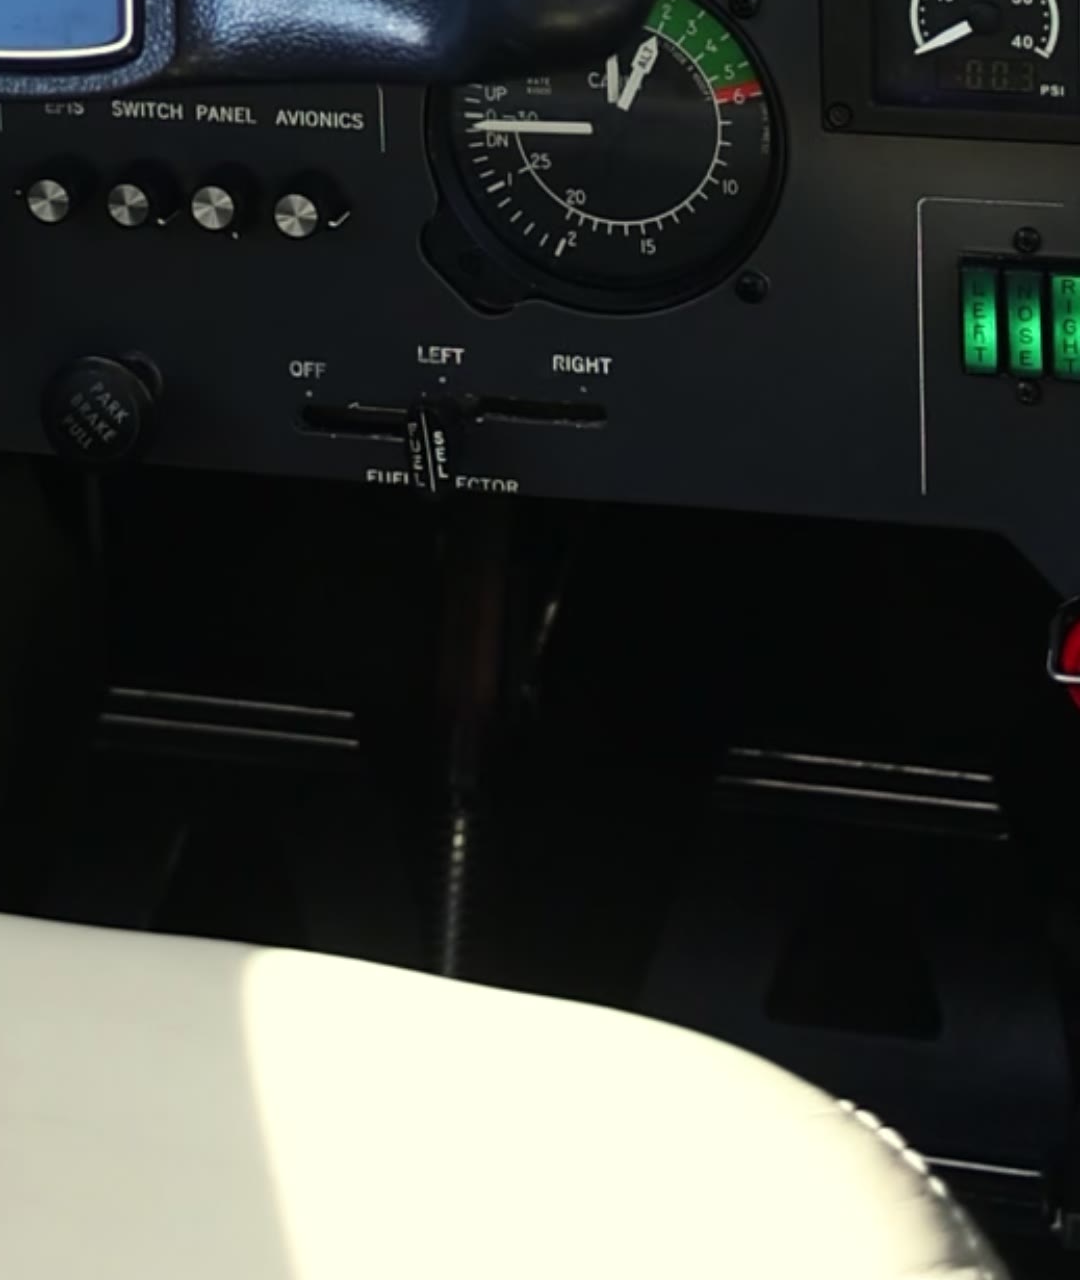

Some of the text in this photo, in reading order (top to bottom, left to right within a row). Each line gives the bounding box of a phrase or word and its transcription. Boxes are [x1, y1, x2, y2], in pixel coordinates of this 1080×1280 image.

[1040, 85, 1065, 97] PSI
[111, 101, 184, 121] SWITCH
[196, 105, 257, 125] PANEL
[275, 109, 365, 131] AVIONICS
[418, 347, 464, 365] LEFT
[552, 355, 612, 374] RIGHT
[289, 362, 325, 378] OFF
